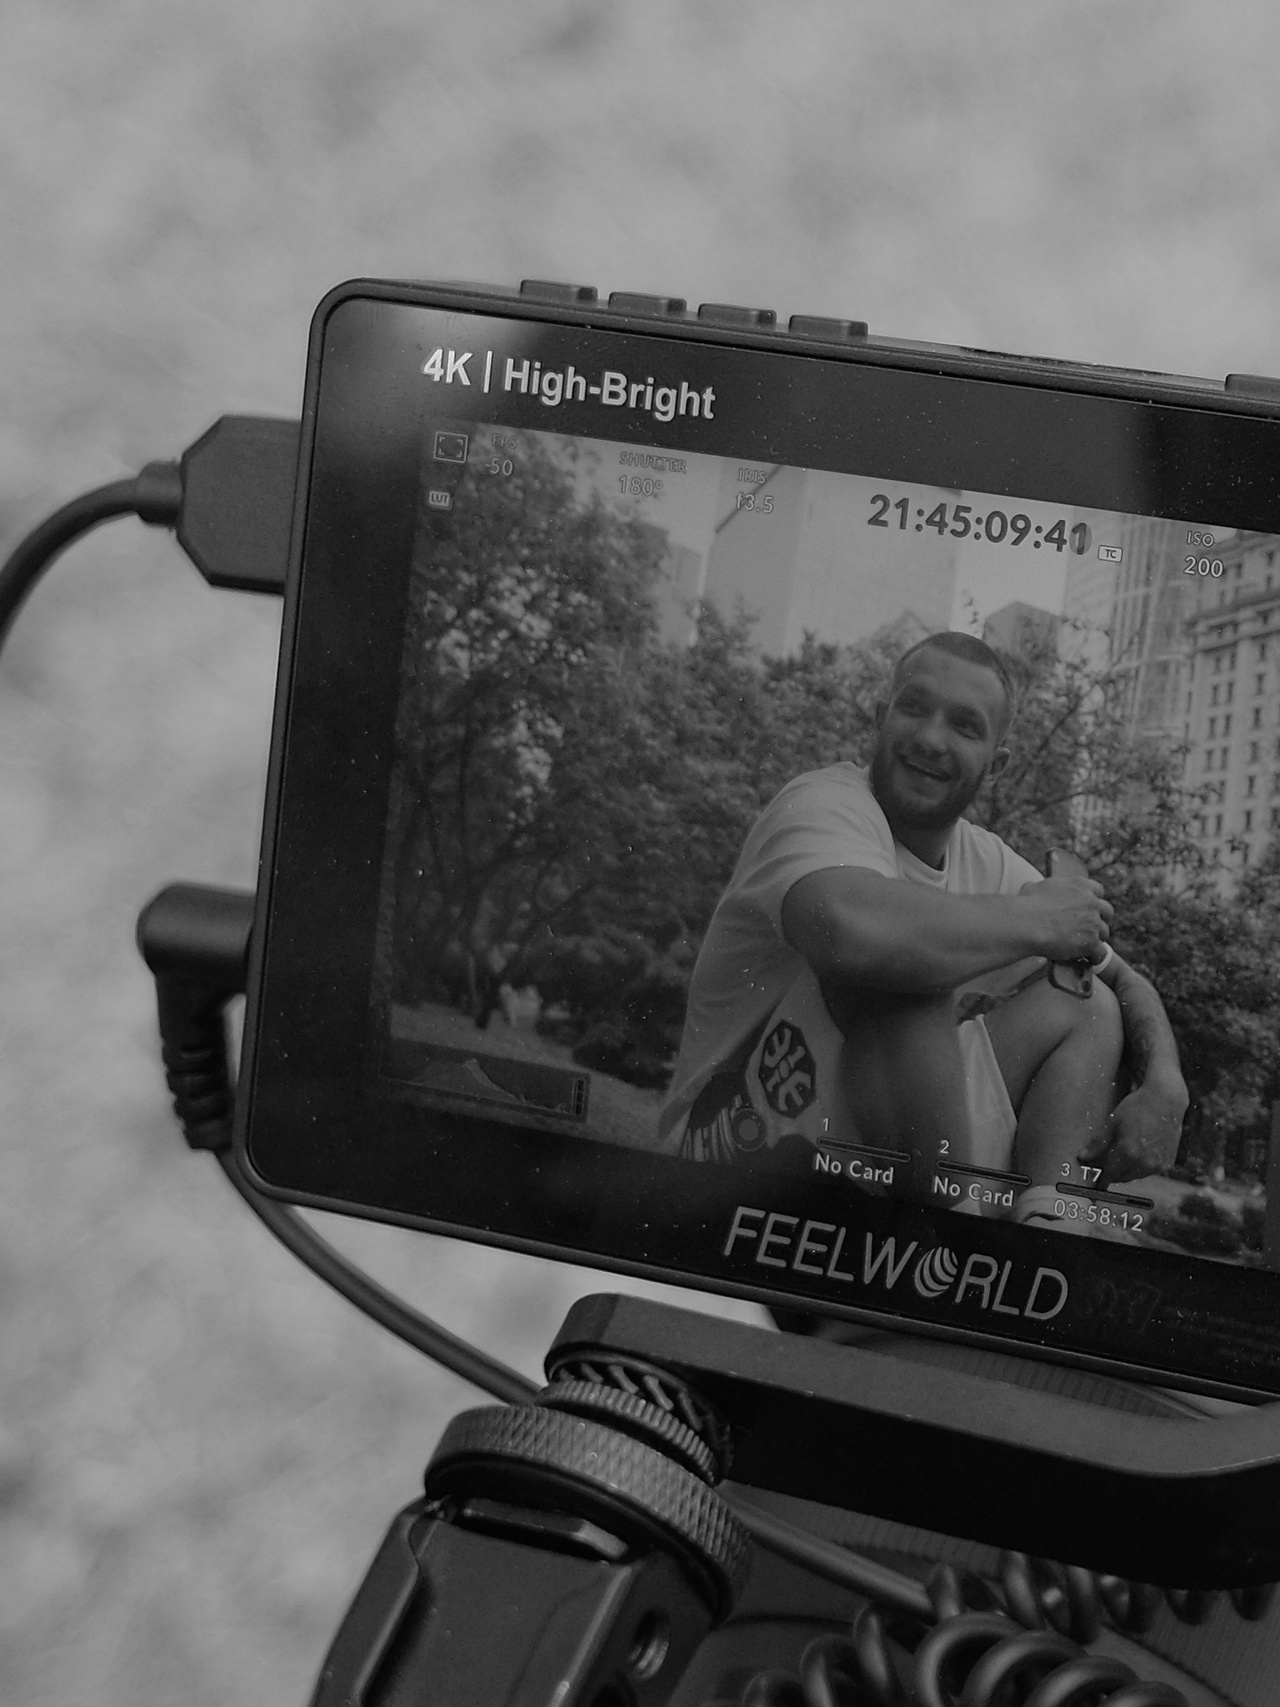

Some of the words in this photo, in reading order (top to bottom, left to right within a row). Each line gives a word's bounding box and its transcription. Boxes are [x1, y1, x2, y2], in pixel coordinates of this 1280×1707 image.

[421, 348, 473, 387] 4K
[504, 357, 716, 422] High-Bright
[619, 450, 687, 474] SHUTTER
[618, 474, 664, 497] 180°
[738, 467, 768, 484] IRIS
[735, 492, 774, 513] f3.5
[1186, 530, 1215, 547] ISO
[1104, 549, 1117, 559] TC
[1184, 555, 1224, 579] 200
[822, 1117, 830, 1132] 1
[940, 1140, 950, 1155] 2
[815, 1153, 842, 1175] No
[849, 1160, 894, 1185] Card
[1061, 1162, 1071, 1177] 3
[1081, 1165, 1103, 1184] T7
[933, 1176, 961, 1198] No
[968, 1183, 1014, 1207] Card
[1054, 1199, 1145, 1233] 03:58:12
